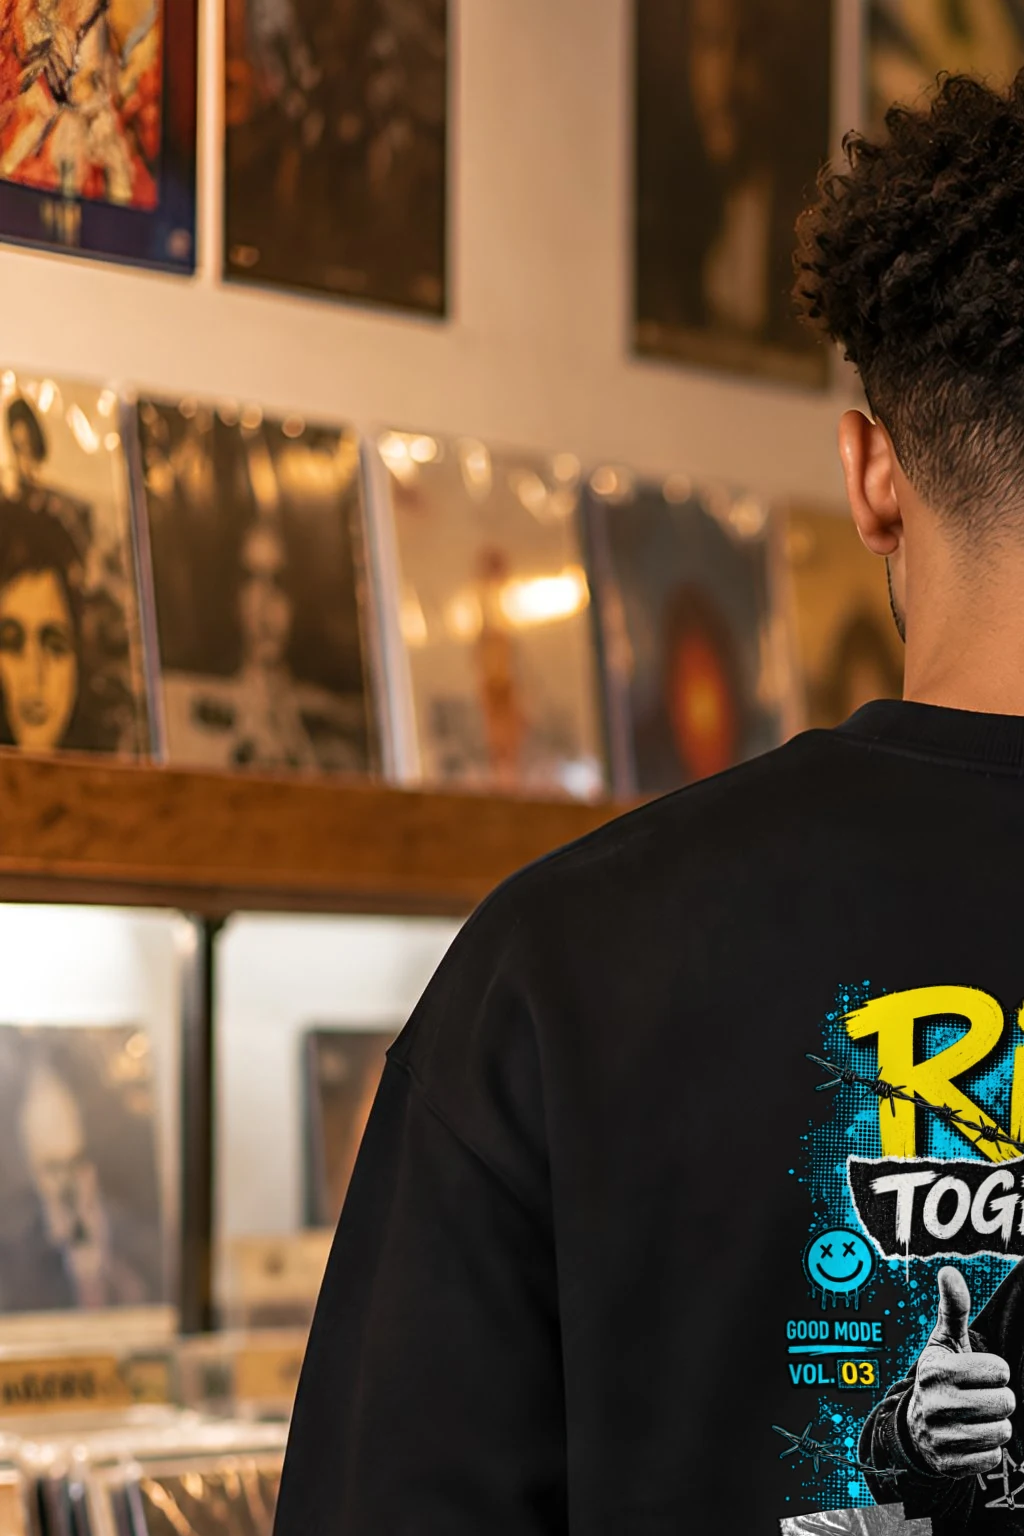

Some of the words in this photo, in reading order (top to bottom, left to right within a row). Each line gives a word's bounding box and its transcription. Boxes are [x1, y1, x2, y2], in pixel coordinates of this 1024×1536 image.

[786, 1319, 829, 1340] GOOD
[834, 1321, 883, 1342] MODE
[788, 1363, 835, 1385] VOL.
[841, 1361, 875, 1385] 03
